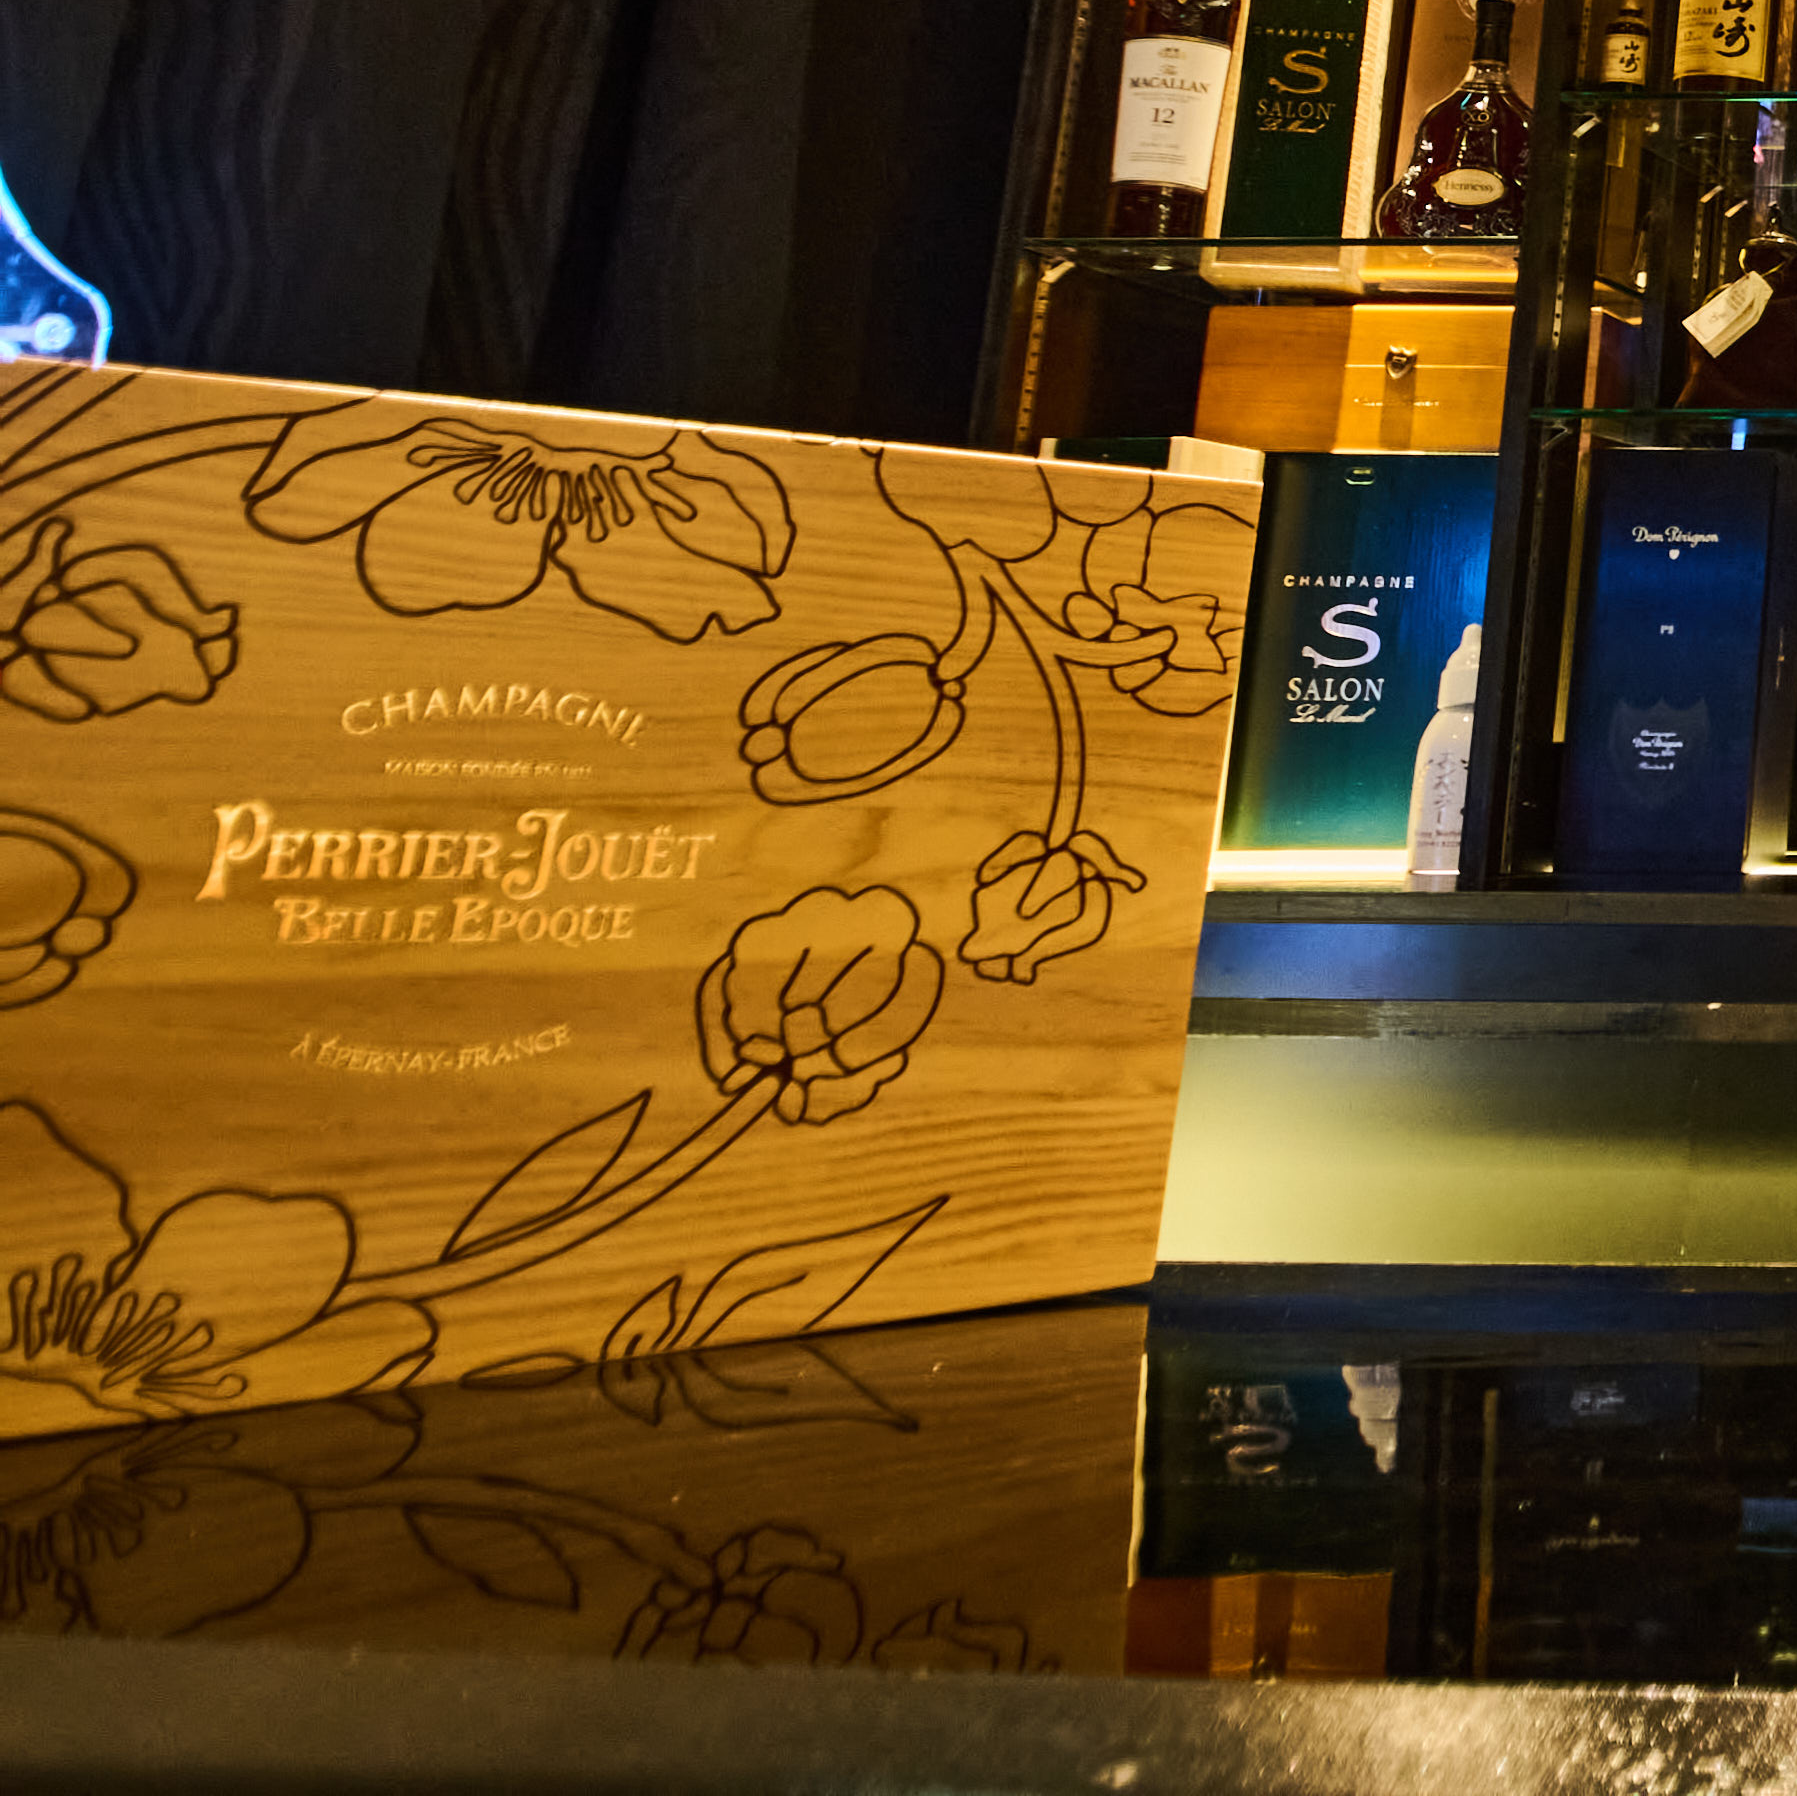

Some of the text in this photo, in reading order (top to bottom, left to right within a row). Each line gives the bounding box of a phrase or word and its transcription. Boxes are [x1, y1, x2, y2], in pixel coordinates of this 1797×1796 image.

[1268, 46, 1330, 95] S
[1129, 76, 1212, 94] MACALLAN
[1151, 107, 1176, 125] 12
[1256, 97, 1336, 121] SALON
[1631, 525, 1664, 543] Dom
[1283, 574, 1415, 589] CHAMPAGNE
[1301, 597, 1381, 669] S
[1286, 677, 1385, 702] SALON
[341, 683, 651, 748] CHAMPAGNE
[195, 799, 717, 902] PERRIER-JOUËT
[273, 895, 443, 945] BELLE
